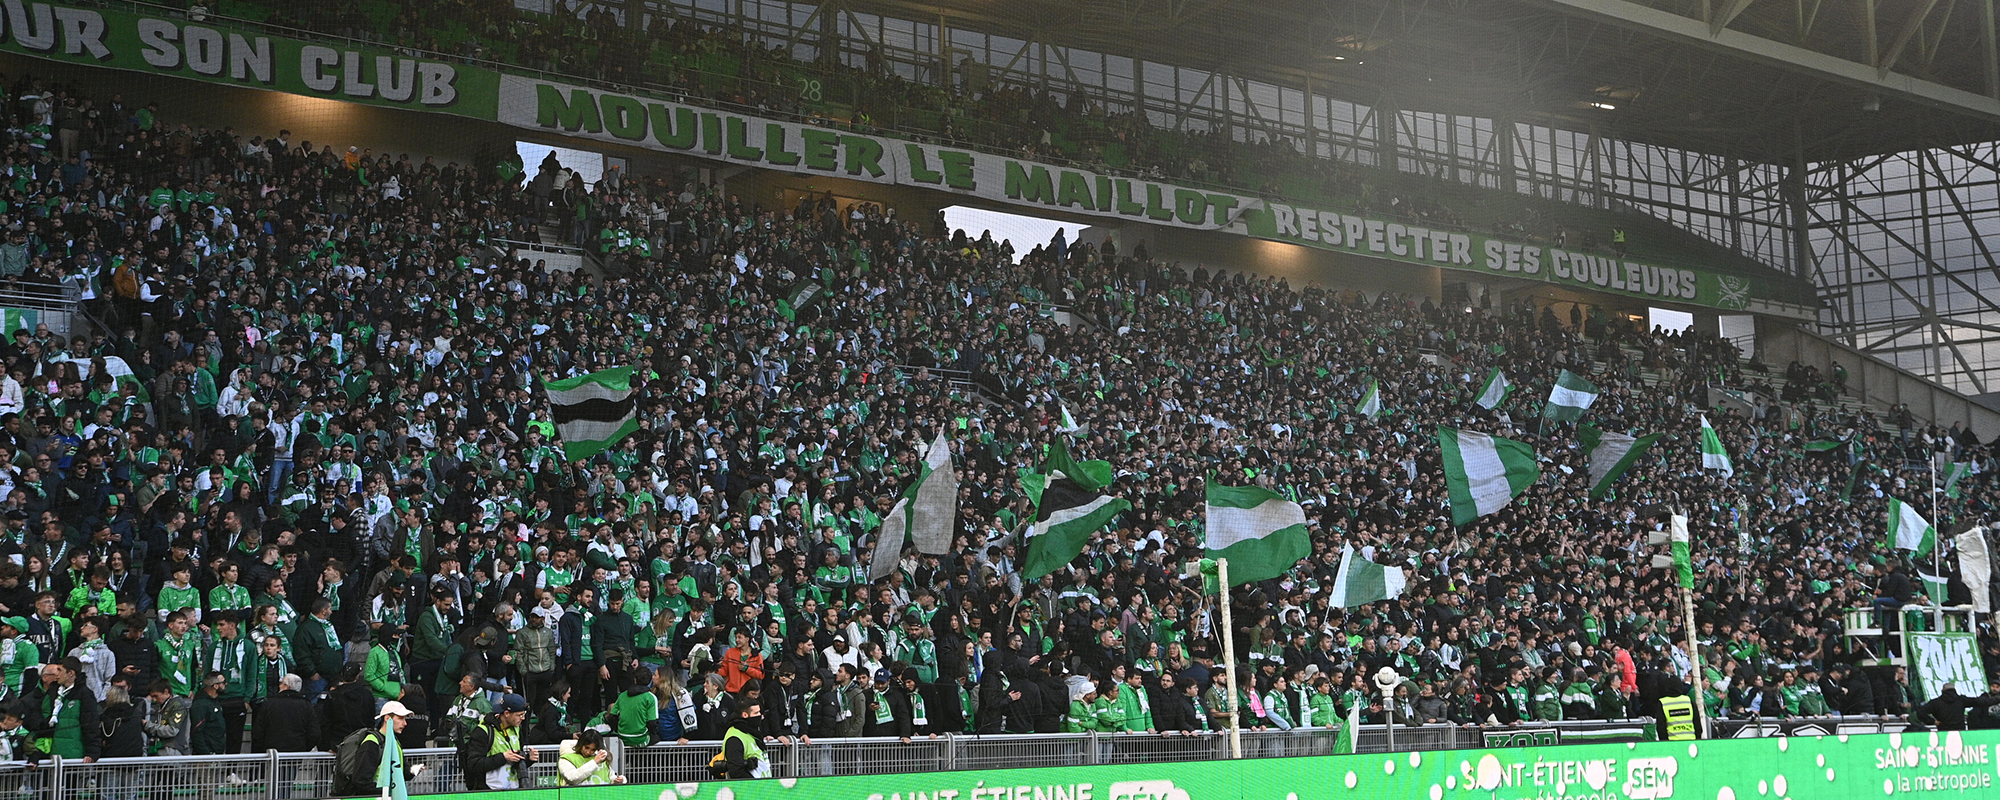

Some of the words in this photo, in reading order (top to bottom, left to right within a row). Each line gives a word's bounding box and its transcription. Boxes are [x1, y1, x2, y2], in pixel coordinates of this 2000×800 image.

[0, 0, 112, 60] UR
[137, 18, 274, 82] SON
[300, 45, 458, 105] CLUB
[798, 78, 821, 101] 28
[536, 84, 885, 178] MOUILLER
[904, 143, 976, 191] LE
[1005, 160, 1239, 226] MAILLOT
[1270, 203, 1473, 265] RESPECTER
[1485, 240, 1542, 274] SES
[1551, 249, 1697, 299] COULEURS
[1917, 636, 1982, 681] ZONE
[1632, 761, 1670, 789] SÉM
[1897, 772, 1912, 792] la
[1915, 769, 1991, 794] métropole
